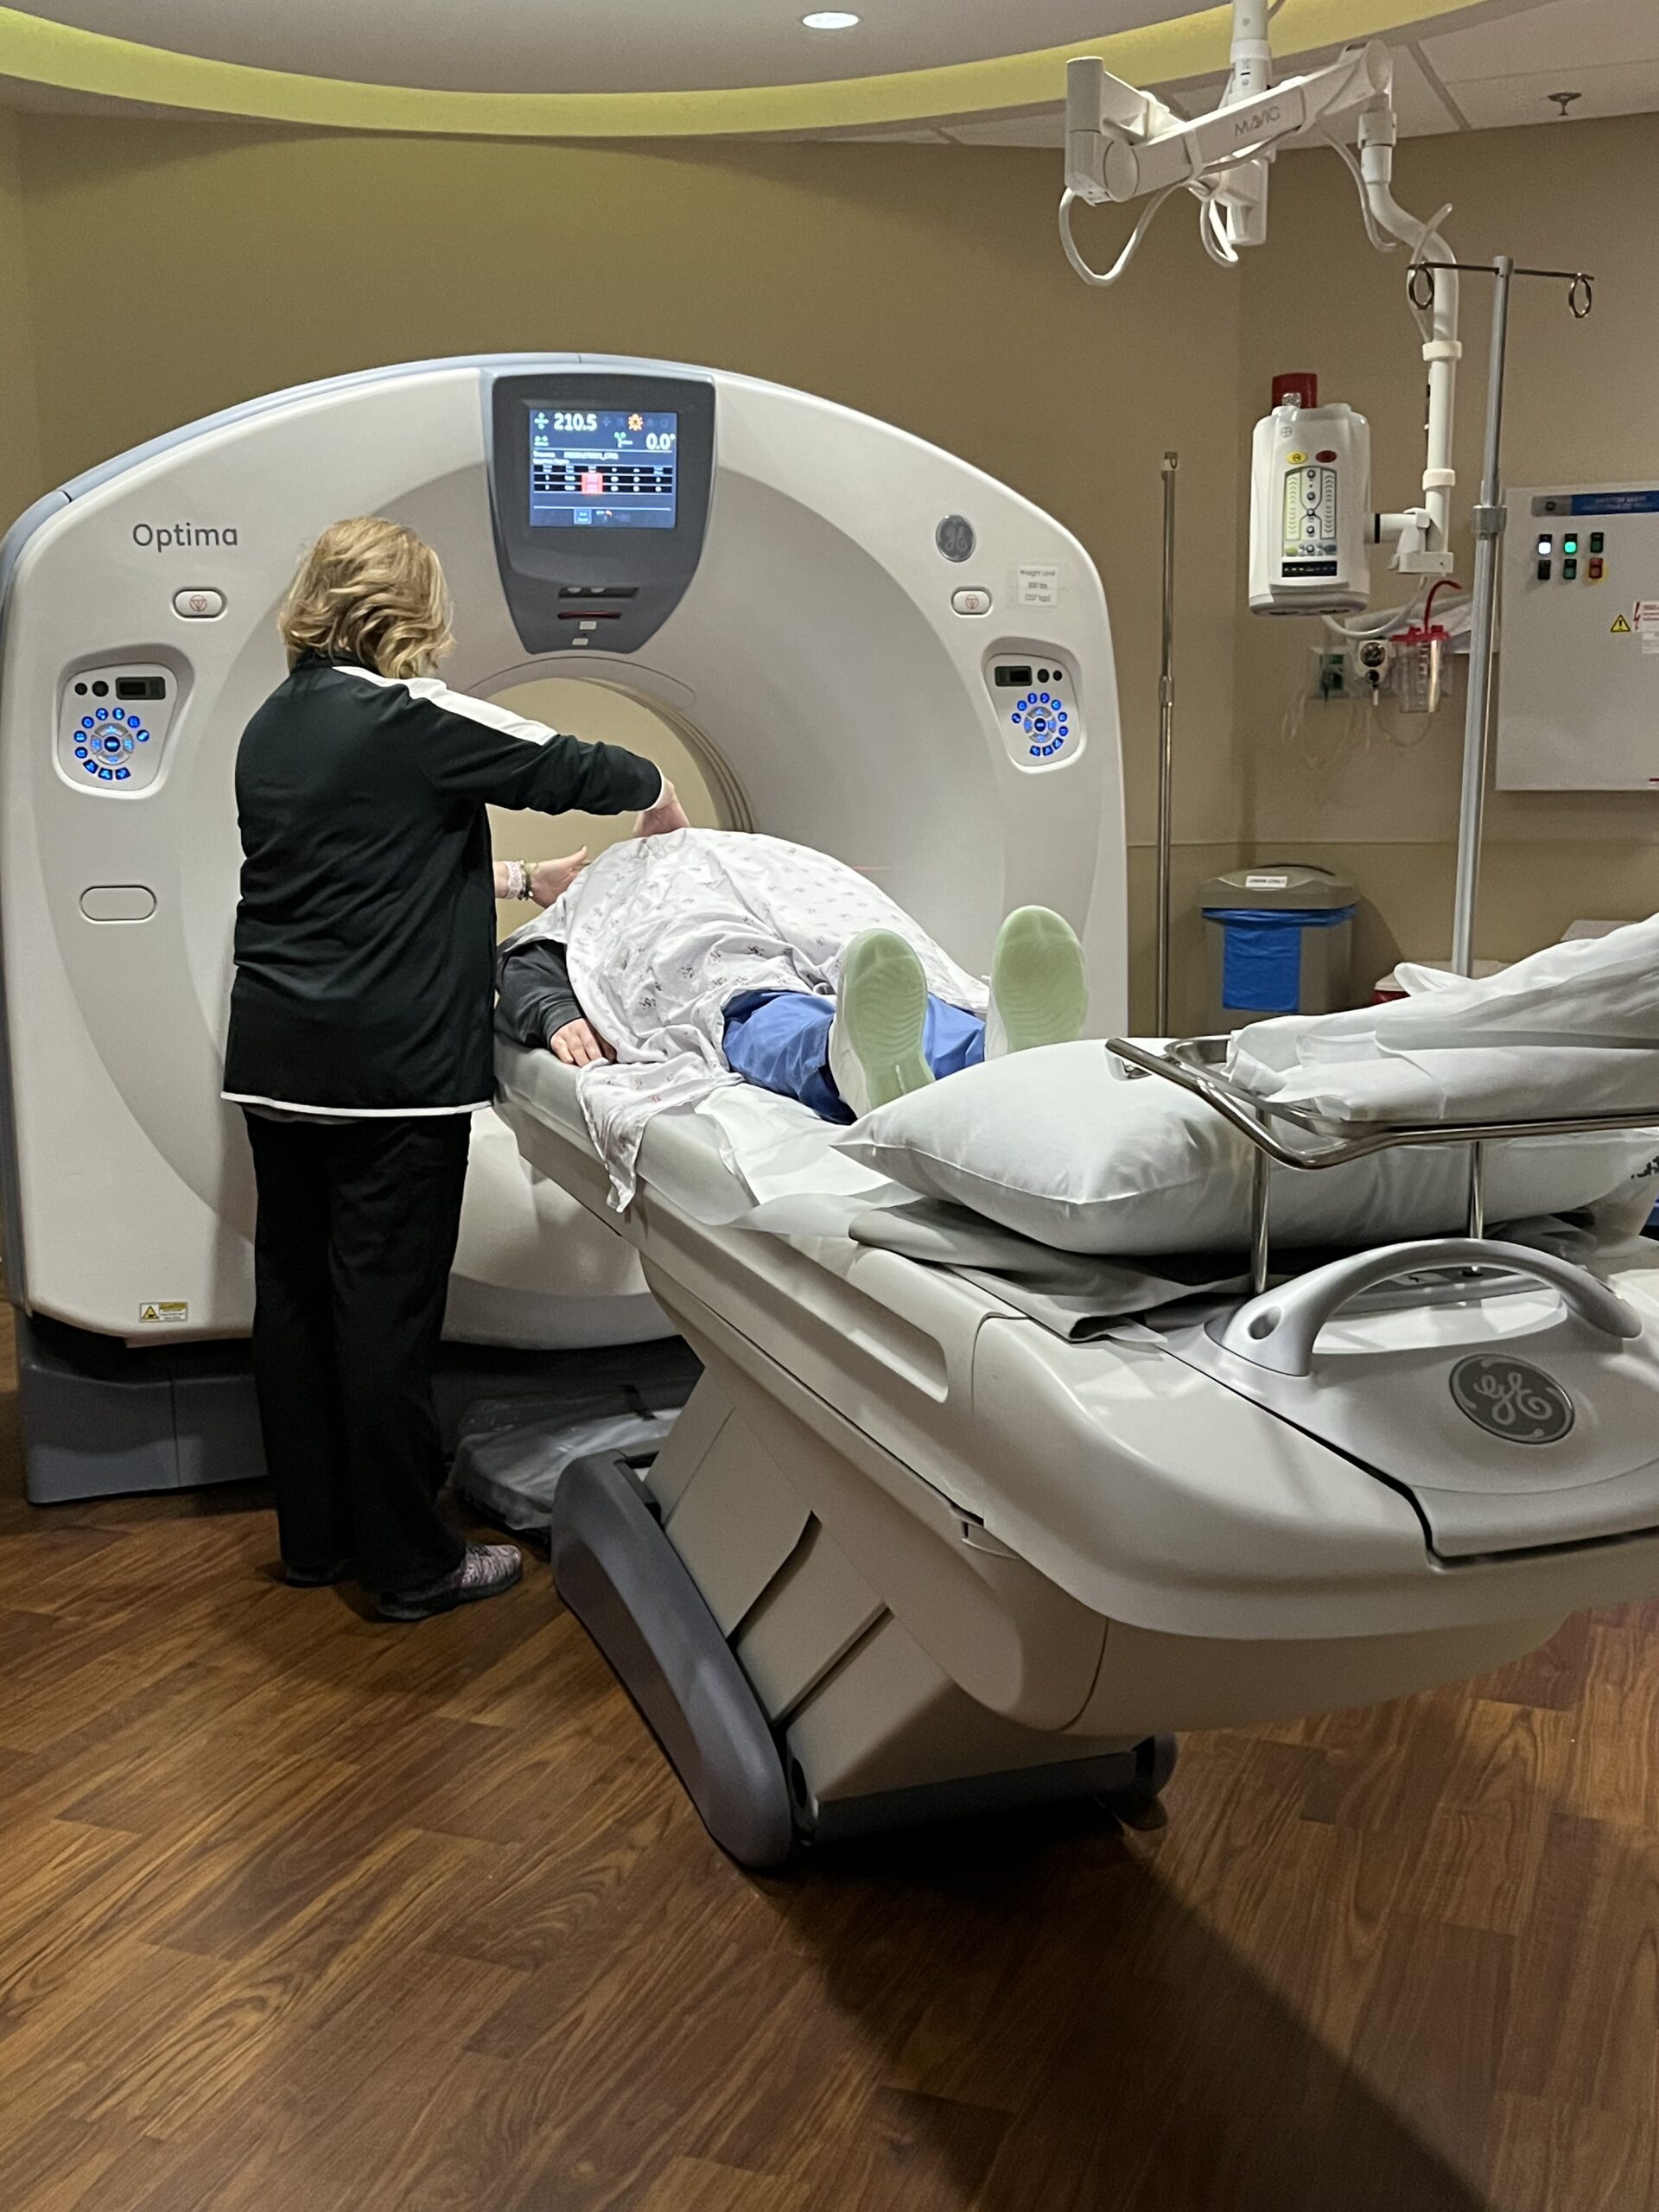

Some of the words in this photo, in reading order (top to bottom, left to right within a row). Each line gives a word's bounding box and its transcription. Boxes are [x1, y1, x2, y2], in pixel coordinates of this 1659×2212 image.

[1234, 105, 1281, 138] MAVIG
[553, 412, 597, 431] 210.5
[132, 522, 238, 553] Optima
